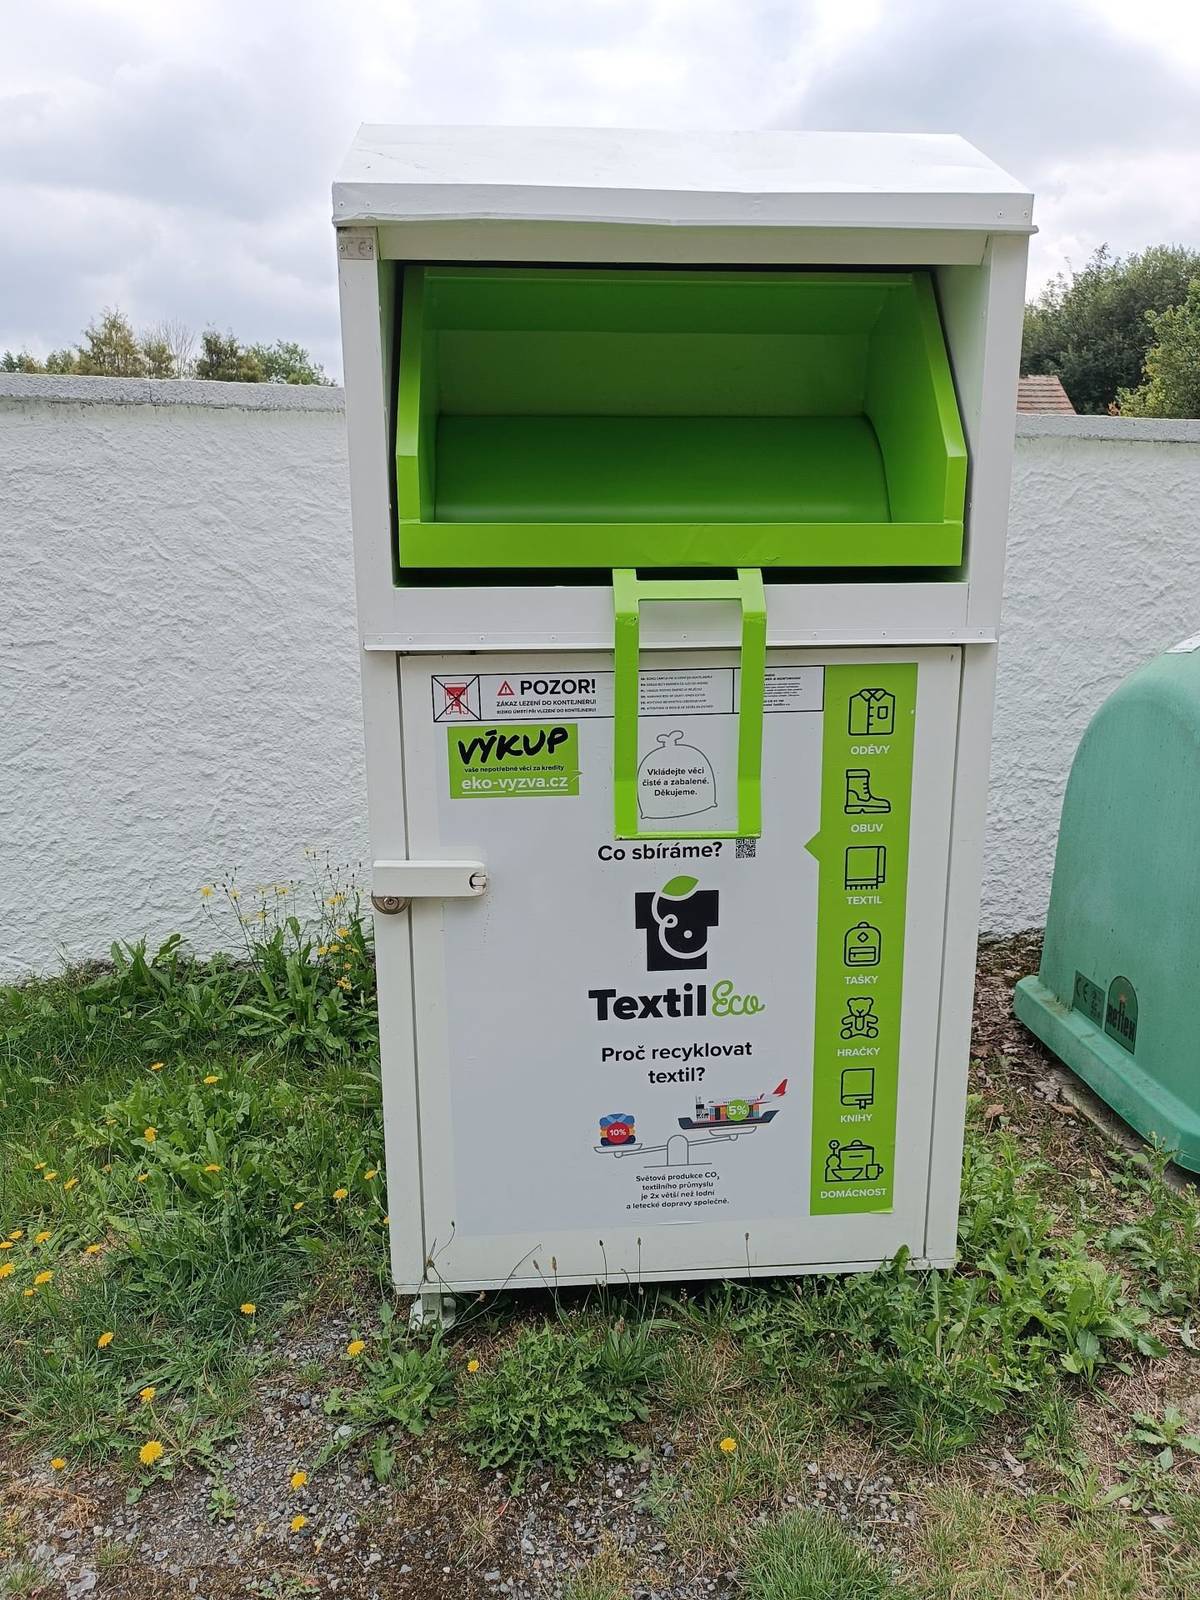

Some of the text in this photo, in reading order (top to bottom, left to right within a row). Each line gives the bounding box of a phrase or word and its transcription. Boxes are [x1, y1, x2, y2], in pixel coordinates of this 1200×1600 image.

[520, 679, 596, 696] POZOR!
[457, 727, 569, 765] VÝKUP
[850, 744, 890, 755] ODĚVY
[480, 765, 518, 774] nepotřebné
[541, 764, 565, 772] kredity
[647, 766, 705, 777] Vkládejte věci
[461, 776, 569, 791] eko-vyzva.cz
[642, 777, 662, 786] čisté
[670, 777, 710, 786] zabalené.
[654, 788, 698, 798] Děkujeme.
[850, 823, 884, 833] OBUV
[597, 841, 723, 861] Co sbíráme?
[846, 896, 883, 905] TEXTIL
[844, 974, 879, 985] TAŠKY
[601, 1042, 753, 1062] Proč recyklovat
[837, 1047, 881, 1057] HRAČKY
[648, 1067, 706, 1084] textil?
[728, 1105, 748, 1116] 5%
[840, 1113, 873, 1123] KNIHY
[609, 1128, 627, 1136] 10%
[636, 1174, 666, 1183] Světová
[667, 1172, 704, 1182] produkce
[642, 1181, 714, 1191] textilního průmyslu
[641, 1189, 715, 1201] je 2x větší než lodní
[820, 1187, 888, 1199] DOMÁCNOST
[632, 1200, 660, 1209] letecké
[661, 1199, 692, 1208] dopravy
[693, 1197, 730, 1207] společné.
